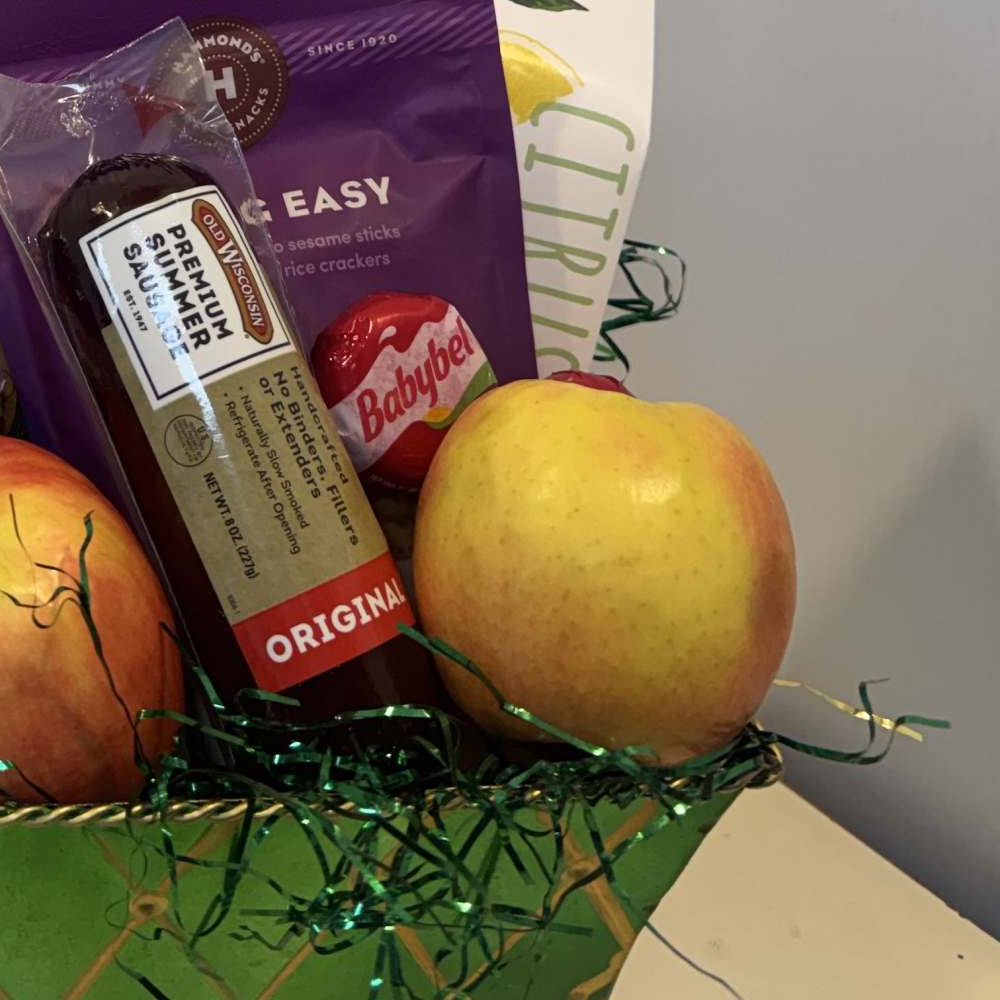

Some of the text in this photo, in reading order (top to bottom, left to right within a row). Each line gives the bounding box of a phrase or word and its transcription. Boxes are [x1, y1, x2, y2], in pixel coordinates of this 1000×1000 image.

[307, 33, 398, 57] SINCE 1920
[233, 87, 270, 132] NACKS
[202, 213, 227, 242] OLD
[282, 176, 390, 218] EASY
[288, 232, 351, 252] sesame
[356, 224, 401, 243] sticks
[146, 232, 212, 350] SUMMER
[166, 223, 234, 340] PREMIUM
[284, 252, 391, 278] rice crackers
[290, 365, 349, 485] Handcrafted
[356, 316, 474, 443] Babybel
[225, 400, 301, 556] Refrigerate After Opening
[241, 394, 311, 529] Naturally Slow Smoked
[259, 376, 321, 499] or Extenders
[273, 370, 359, 546] No Binders, Fillers
[203, 471, 222, 494] NET
[224, 517, 235, 528] 8
[236, 545, 261, 580] (227g)
[265, 577, 407, 664] ORIGINAL
